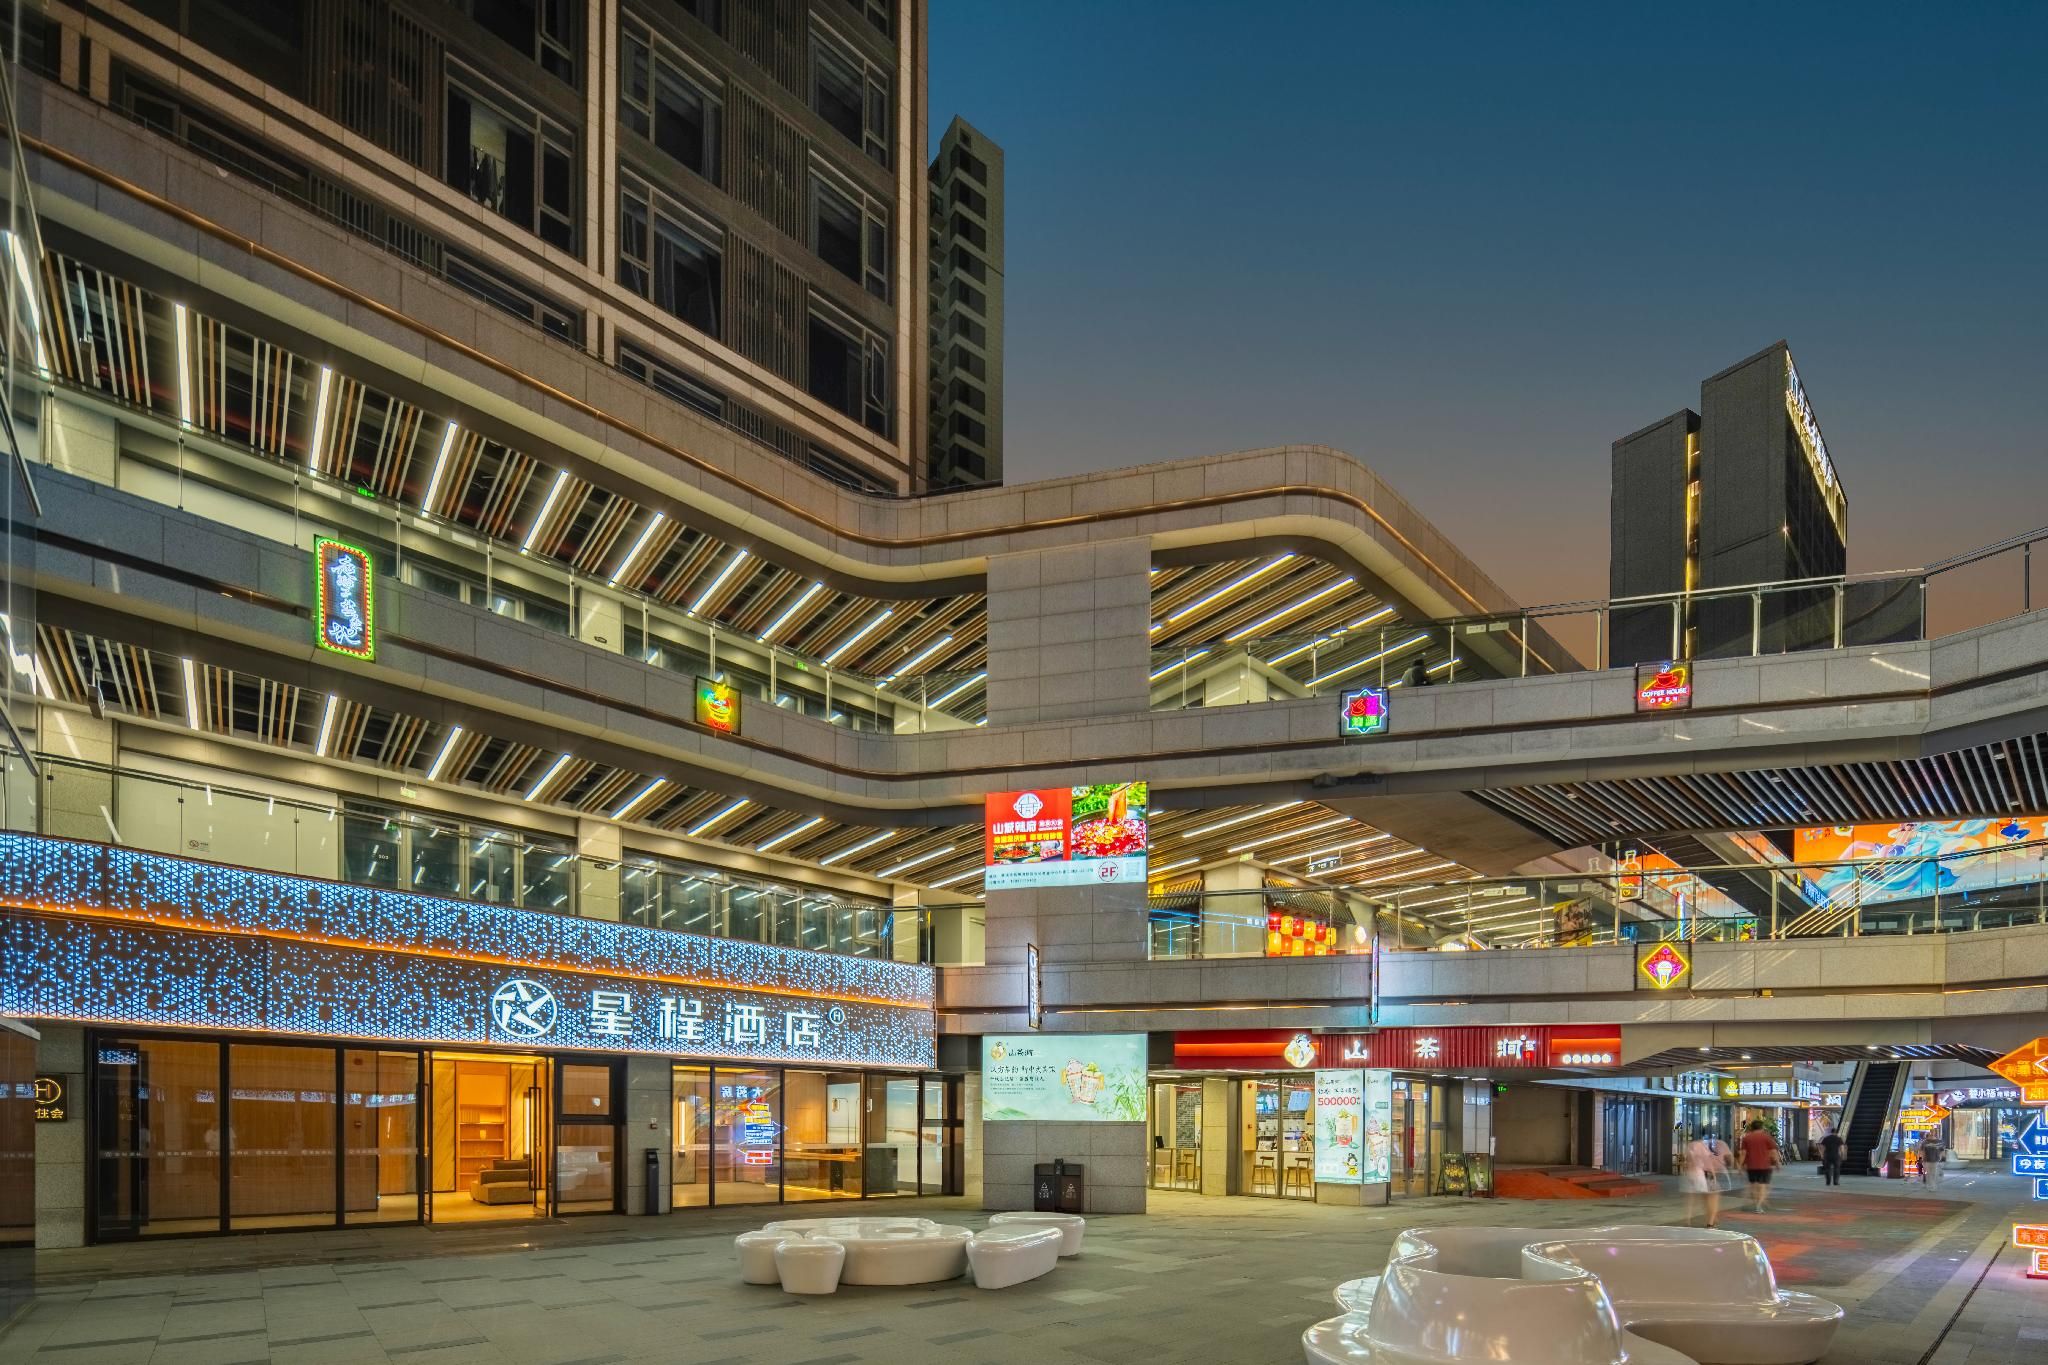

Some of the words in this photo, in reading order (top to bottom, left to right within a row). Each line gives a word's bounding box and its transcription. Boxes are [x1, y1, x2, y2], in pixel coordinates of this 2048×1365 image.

[1641, 690, 1664, 698] COFFEE
[1667, 687, 1687, 696] HOUSE
[1650, 696, 1678, 704] OPEN
[1102, 867, 1117, 878] 2F
[590, 990, 820, 1048] 星程酒店
[1344, 1037, 1523, 1060] 山茶涧
[2020, 1158, 2047, 1171] 今夜
